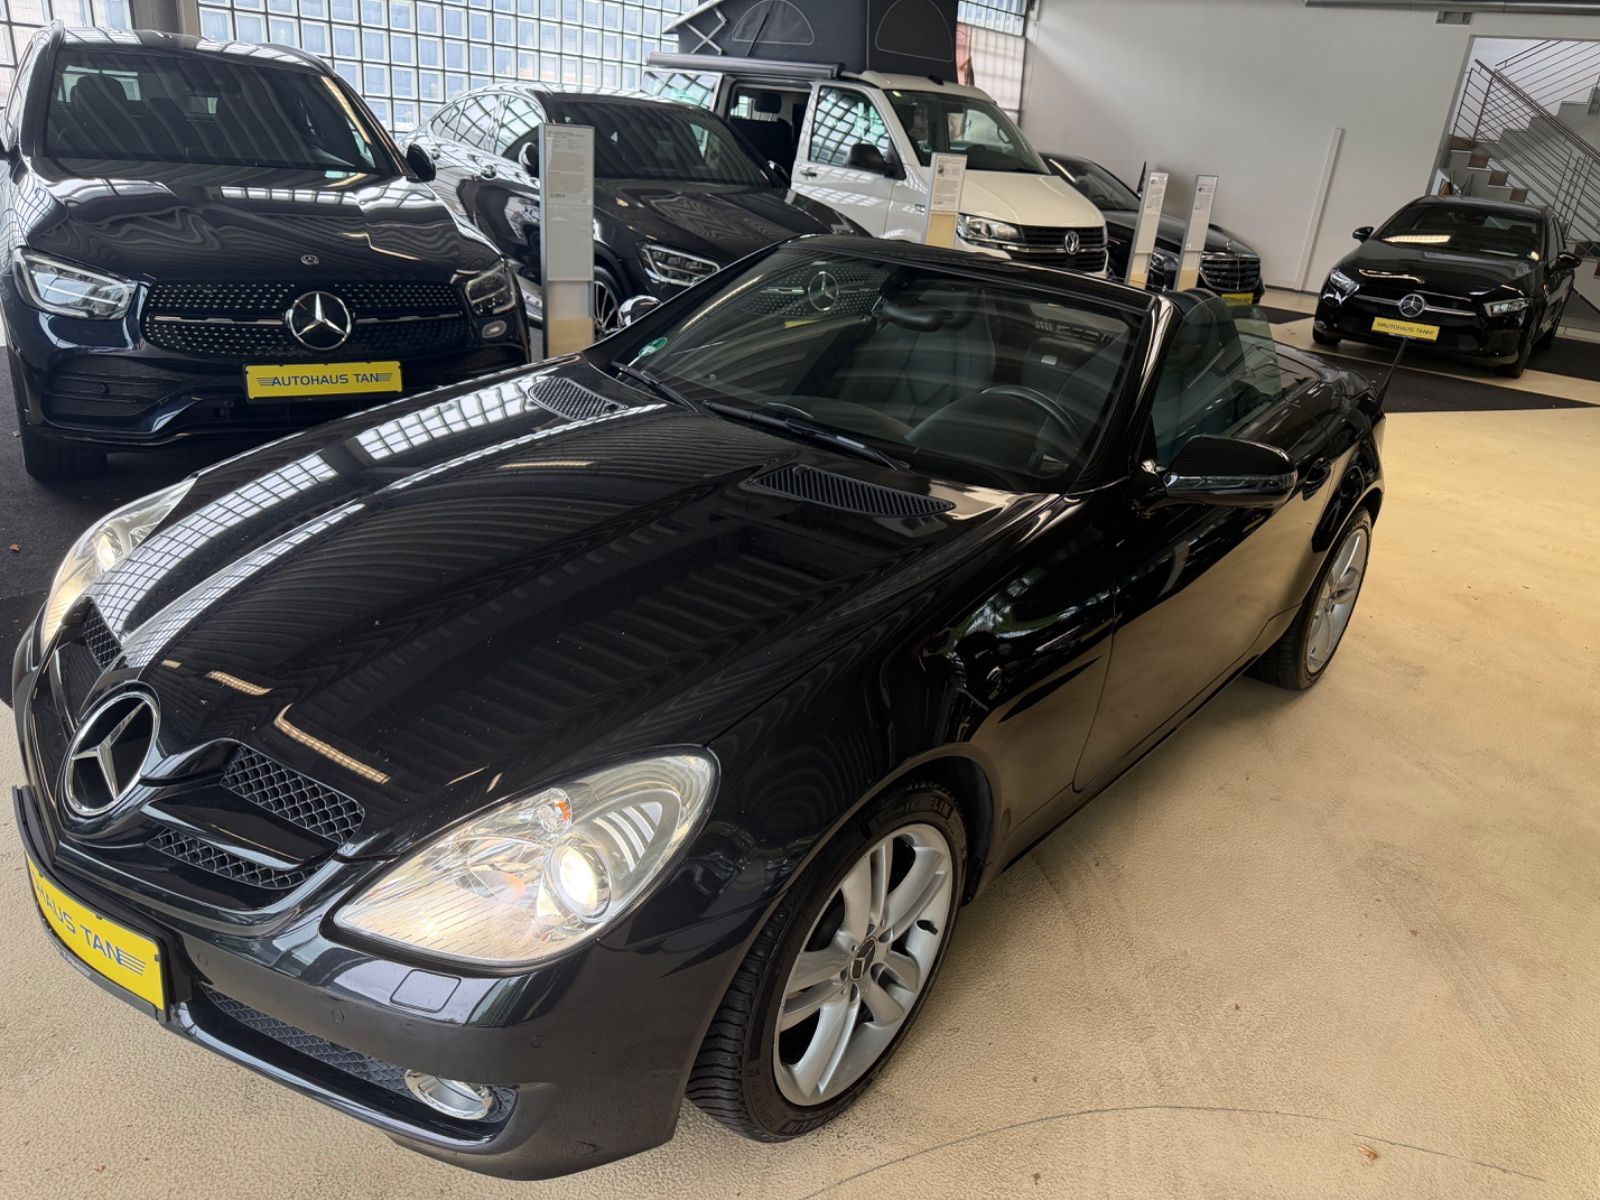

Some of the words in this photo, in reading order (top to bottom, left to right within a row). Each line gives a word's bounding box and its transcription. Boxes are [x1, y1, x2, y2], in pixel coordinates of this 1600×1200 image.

[271, 373, 349, 387] AUTOHAUS
[353, 372, 380, 384] TAN
[79, 923, 123, 966] TAN
